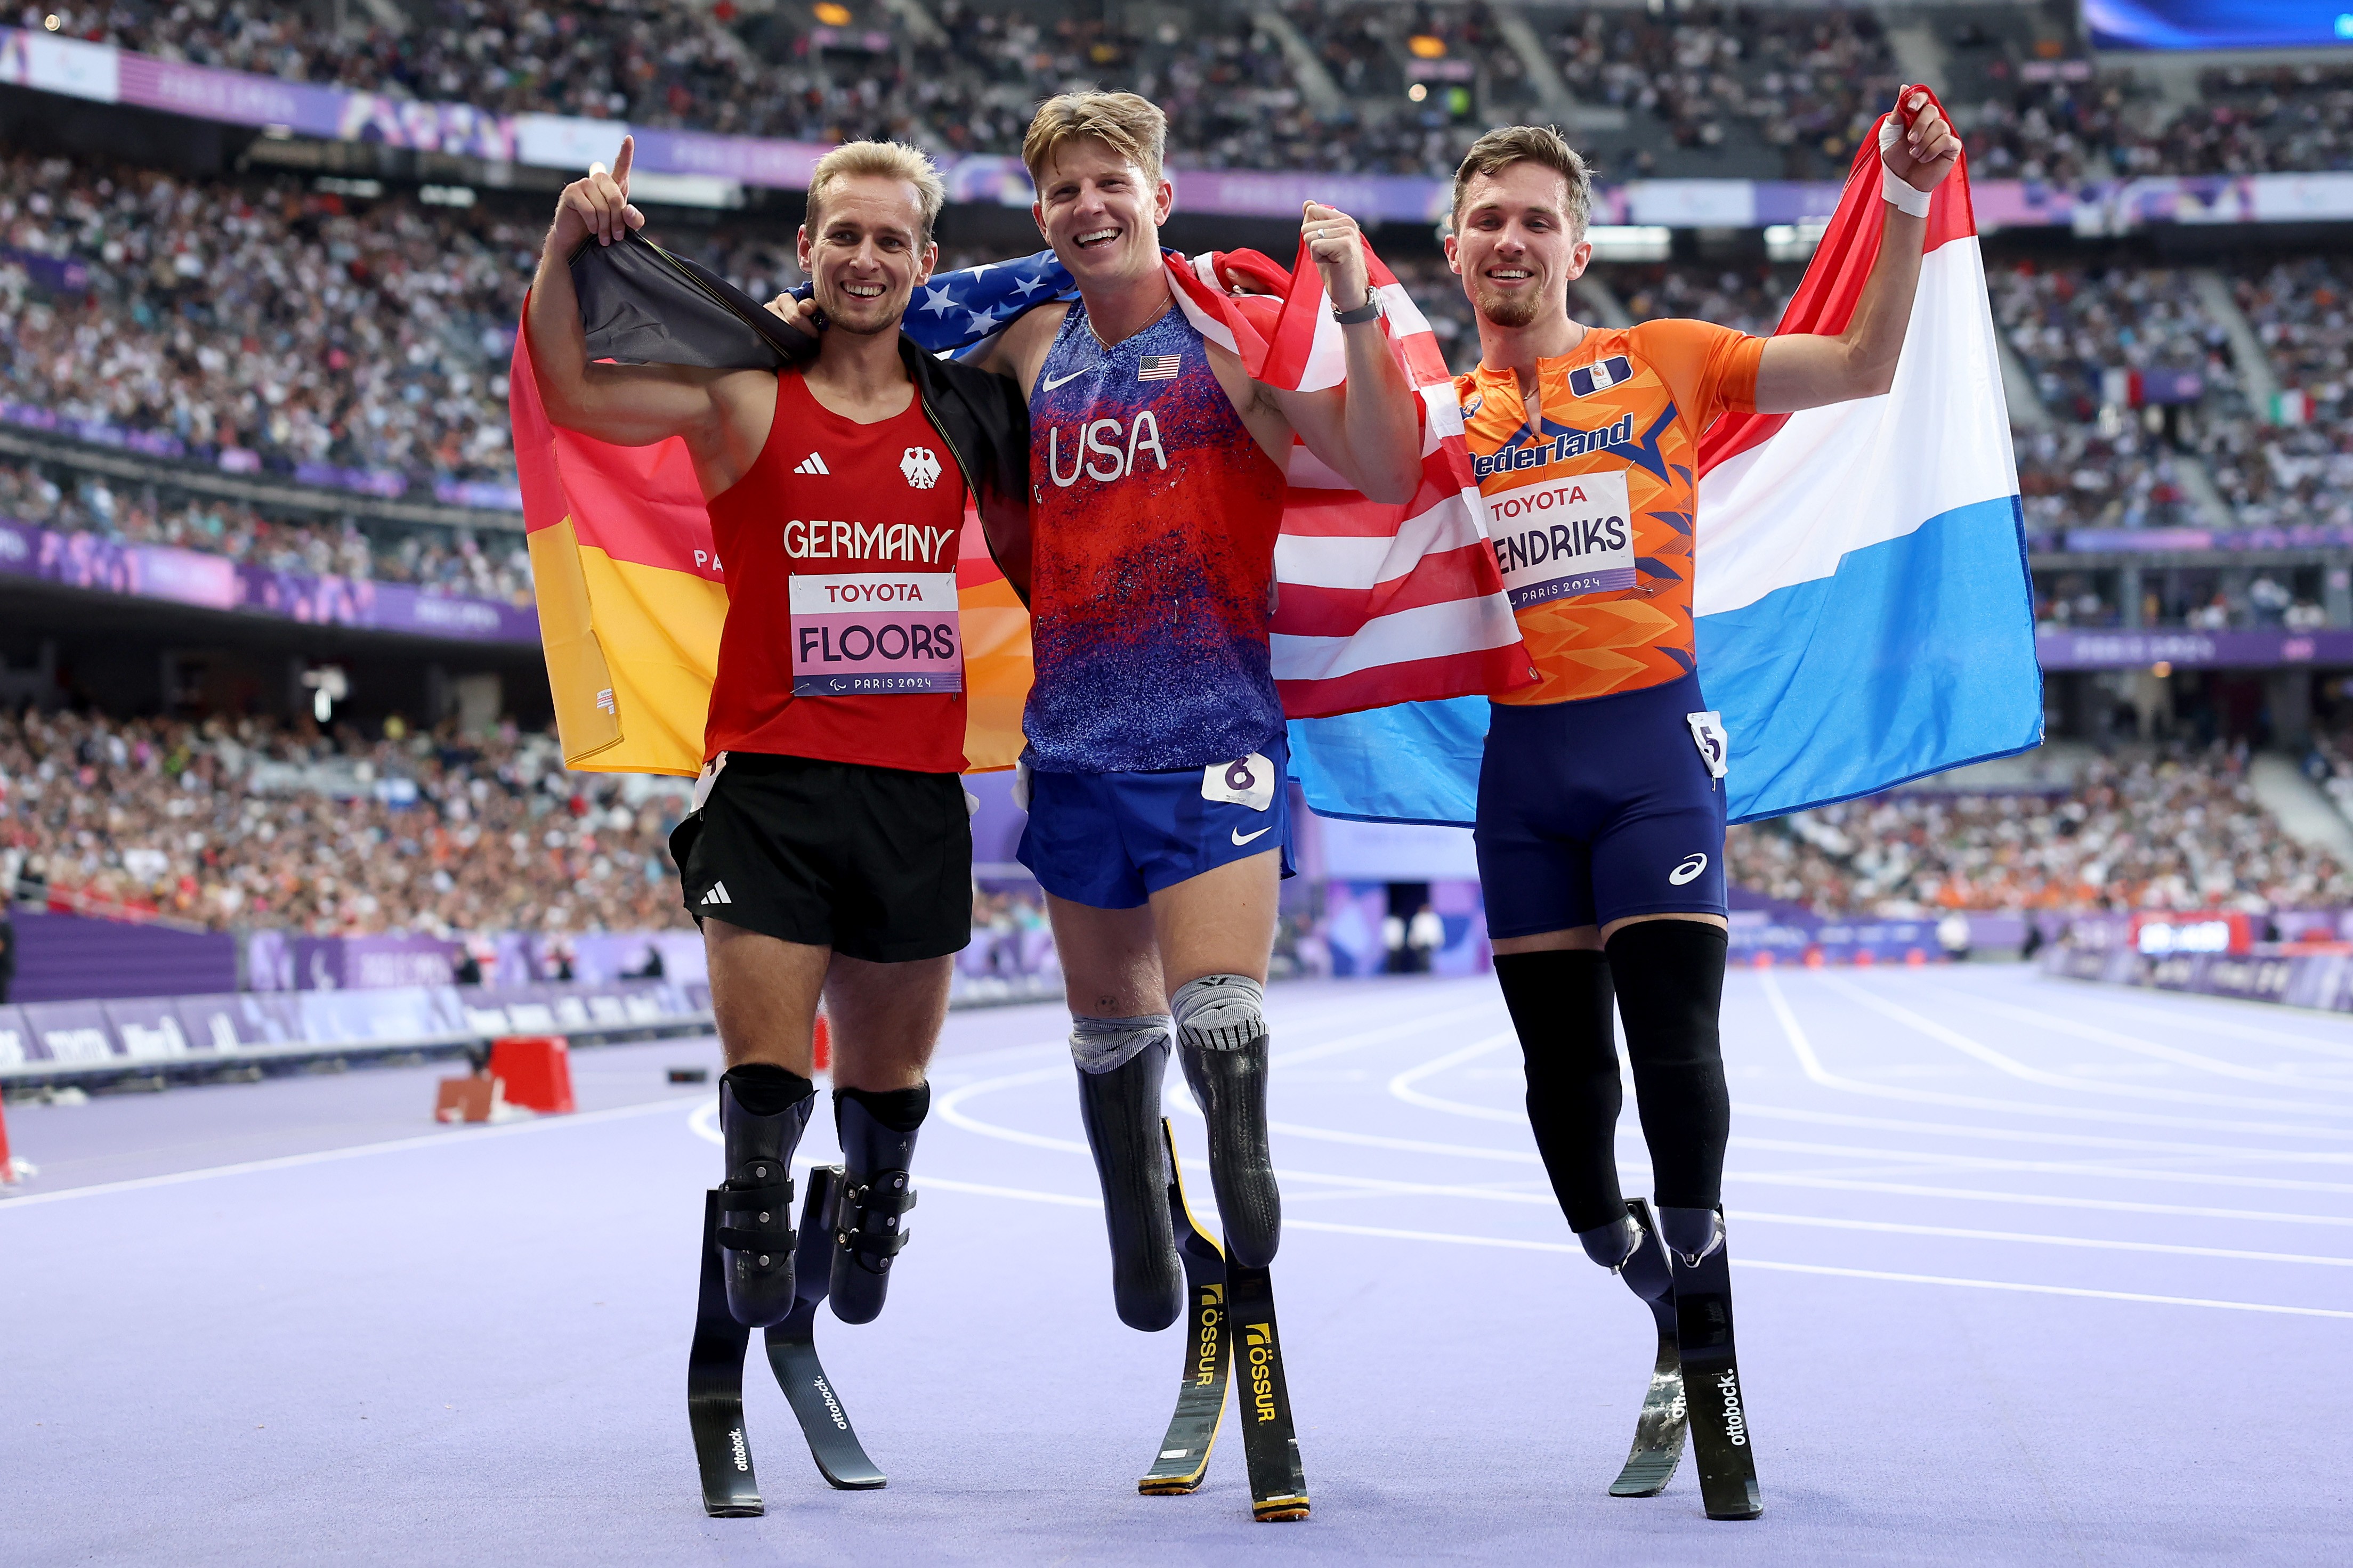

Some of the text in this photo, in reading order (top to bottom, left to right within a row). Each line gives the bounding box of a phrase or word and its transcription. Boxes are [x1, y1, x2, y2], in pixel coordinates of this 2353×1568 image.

[1050, 410, 1167, 487] USA
[1491, 485, 1588, 522] TOYOTA
[783, 520, 955, 564] GERMANY
[824, 583, 923, 603] TOYOTA
[1563, 578, 1600, 593] 2024
[799, 624, 955, 663] FLOORS
[898, 677, 932, 688] 2024
[1700, 726, 1720, 762] 5
[1225, 756, 1255, 790] 6
[1196, 1309, 1223, 1386] ÖSSUR
[1249, 1347, 1275, 1422] ÖSSUR
